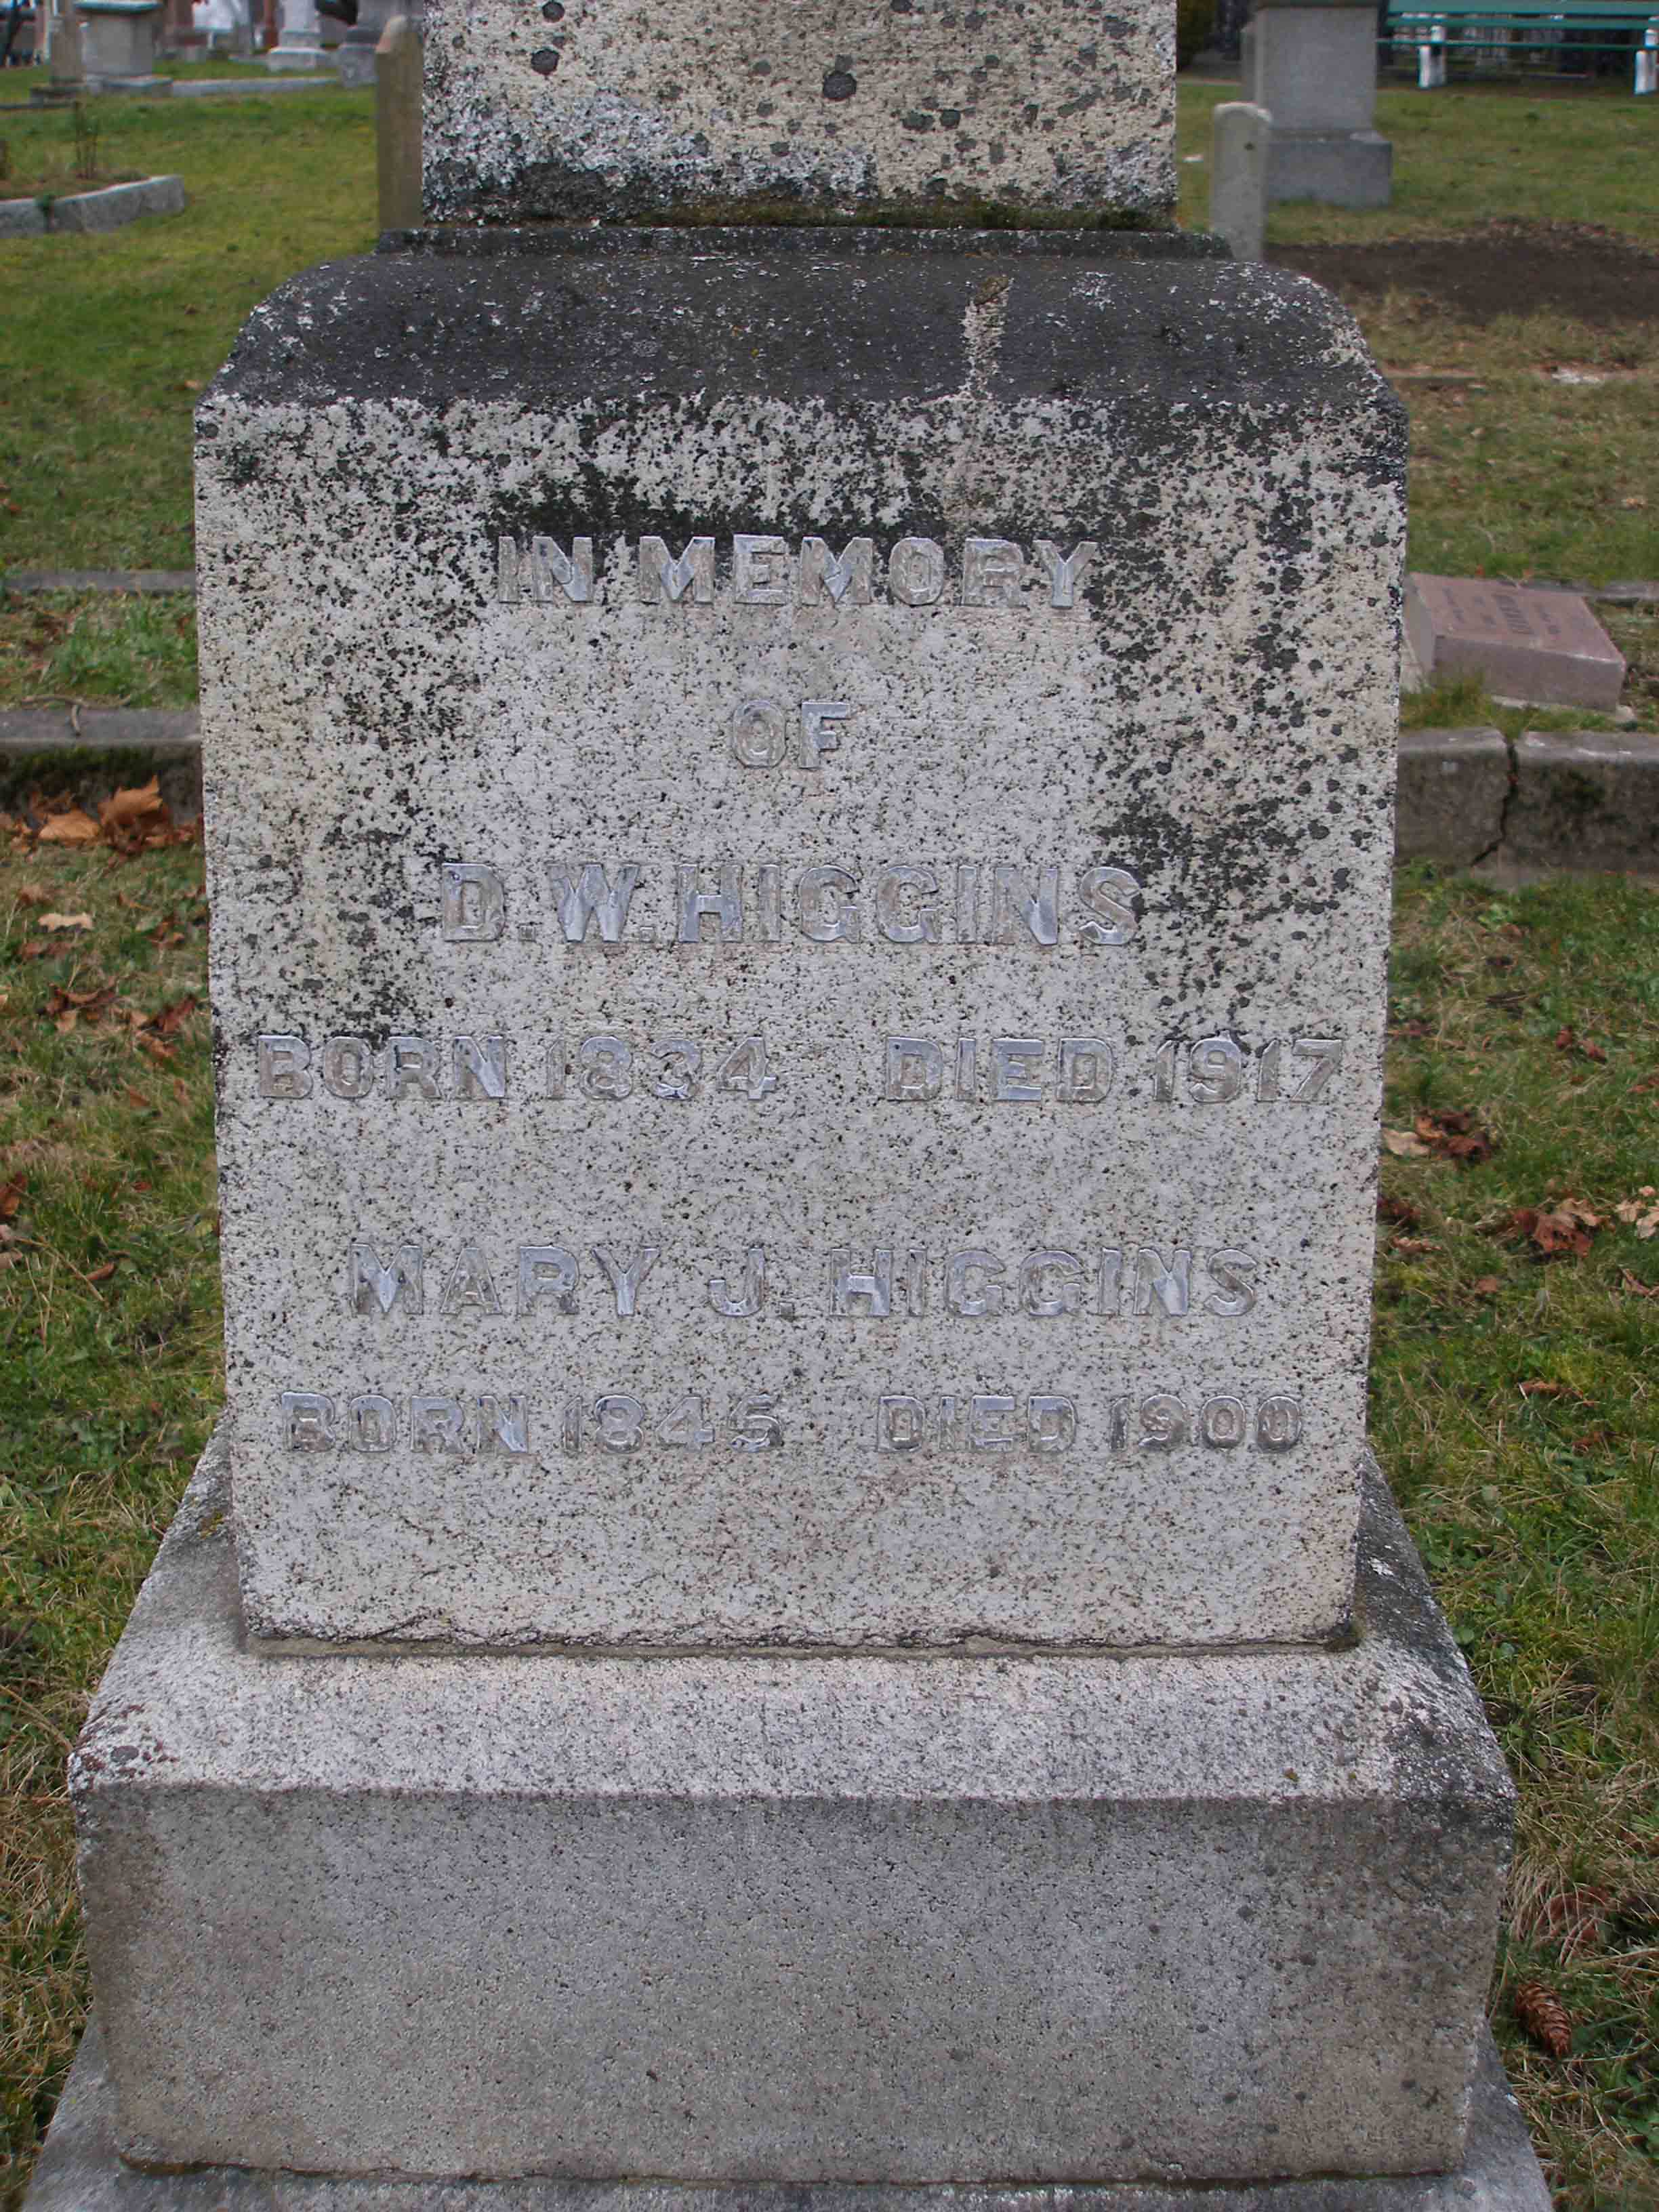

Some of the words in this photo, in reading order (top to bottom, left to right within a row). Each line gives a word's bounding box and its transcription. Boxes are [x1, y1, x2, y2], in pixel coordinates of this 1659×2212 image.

[496, 535, 593, 603] IN
[639, 535, 1097, 609] MEMORY
[731, 700, 851, 769] OF
[676, 864, 1140, 947] HIGGINS
[257, 1035, 507, 1100] BORN
[544, 1035, 778, 1101] 1834
[886, 1035, 1115, 1103] DIED
[1153, 1035, 1345, 1104] 1917
[350, 1243, 661, 1317] MARY
[709, 1247, 796, 1318] J.
[829, 1247, 1258, 1318] HIGGINS
[281, 1391, 529, 1454] BORN
[561, 1391, 784, 1454] 1845
[876, 1393, 1078, 1453] DIED
[1109, 1393, 1303, 1454] 1900
